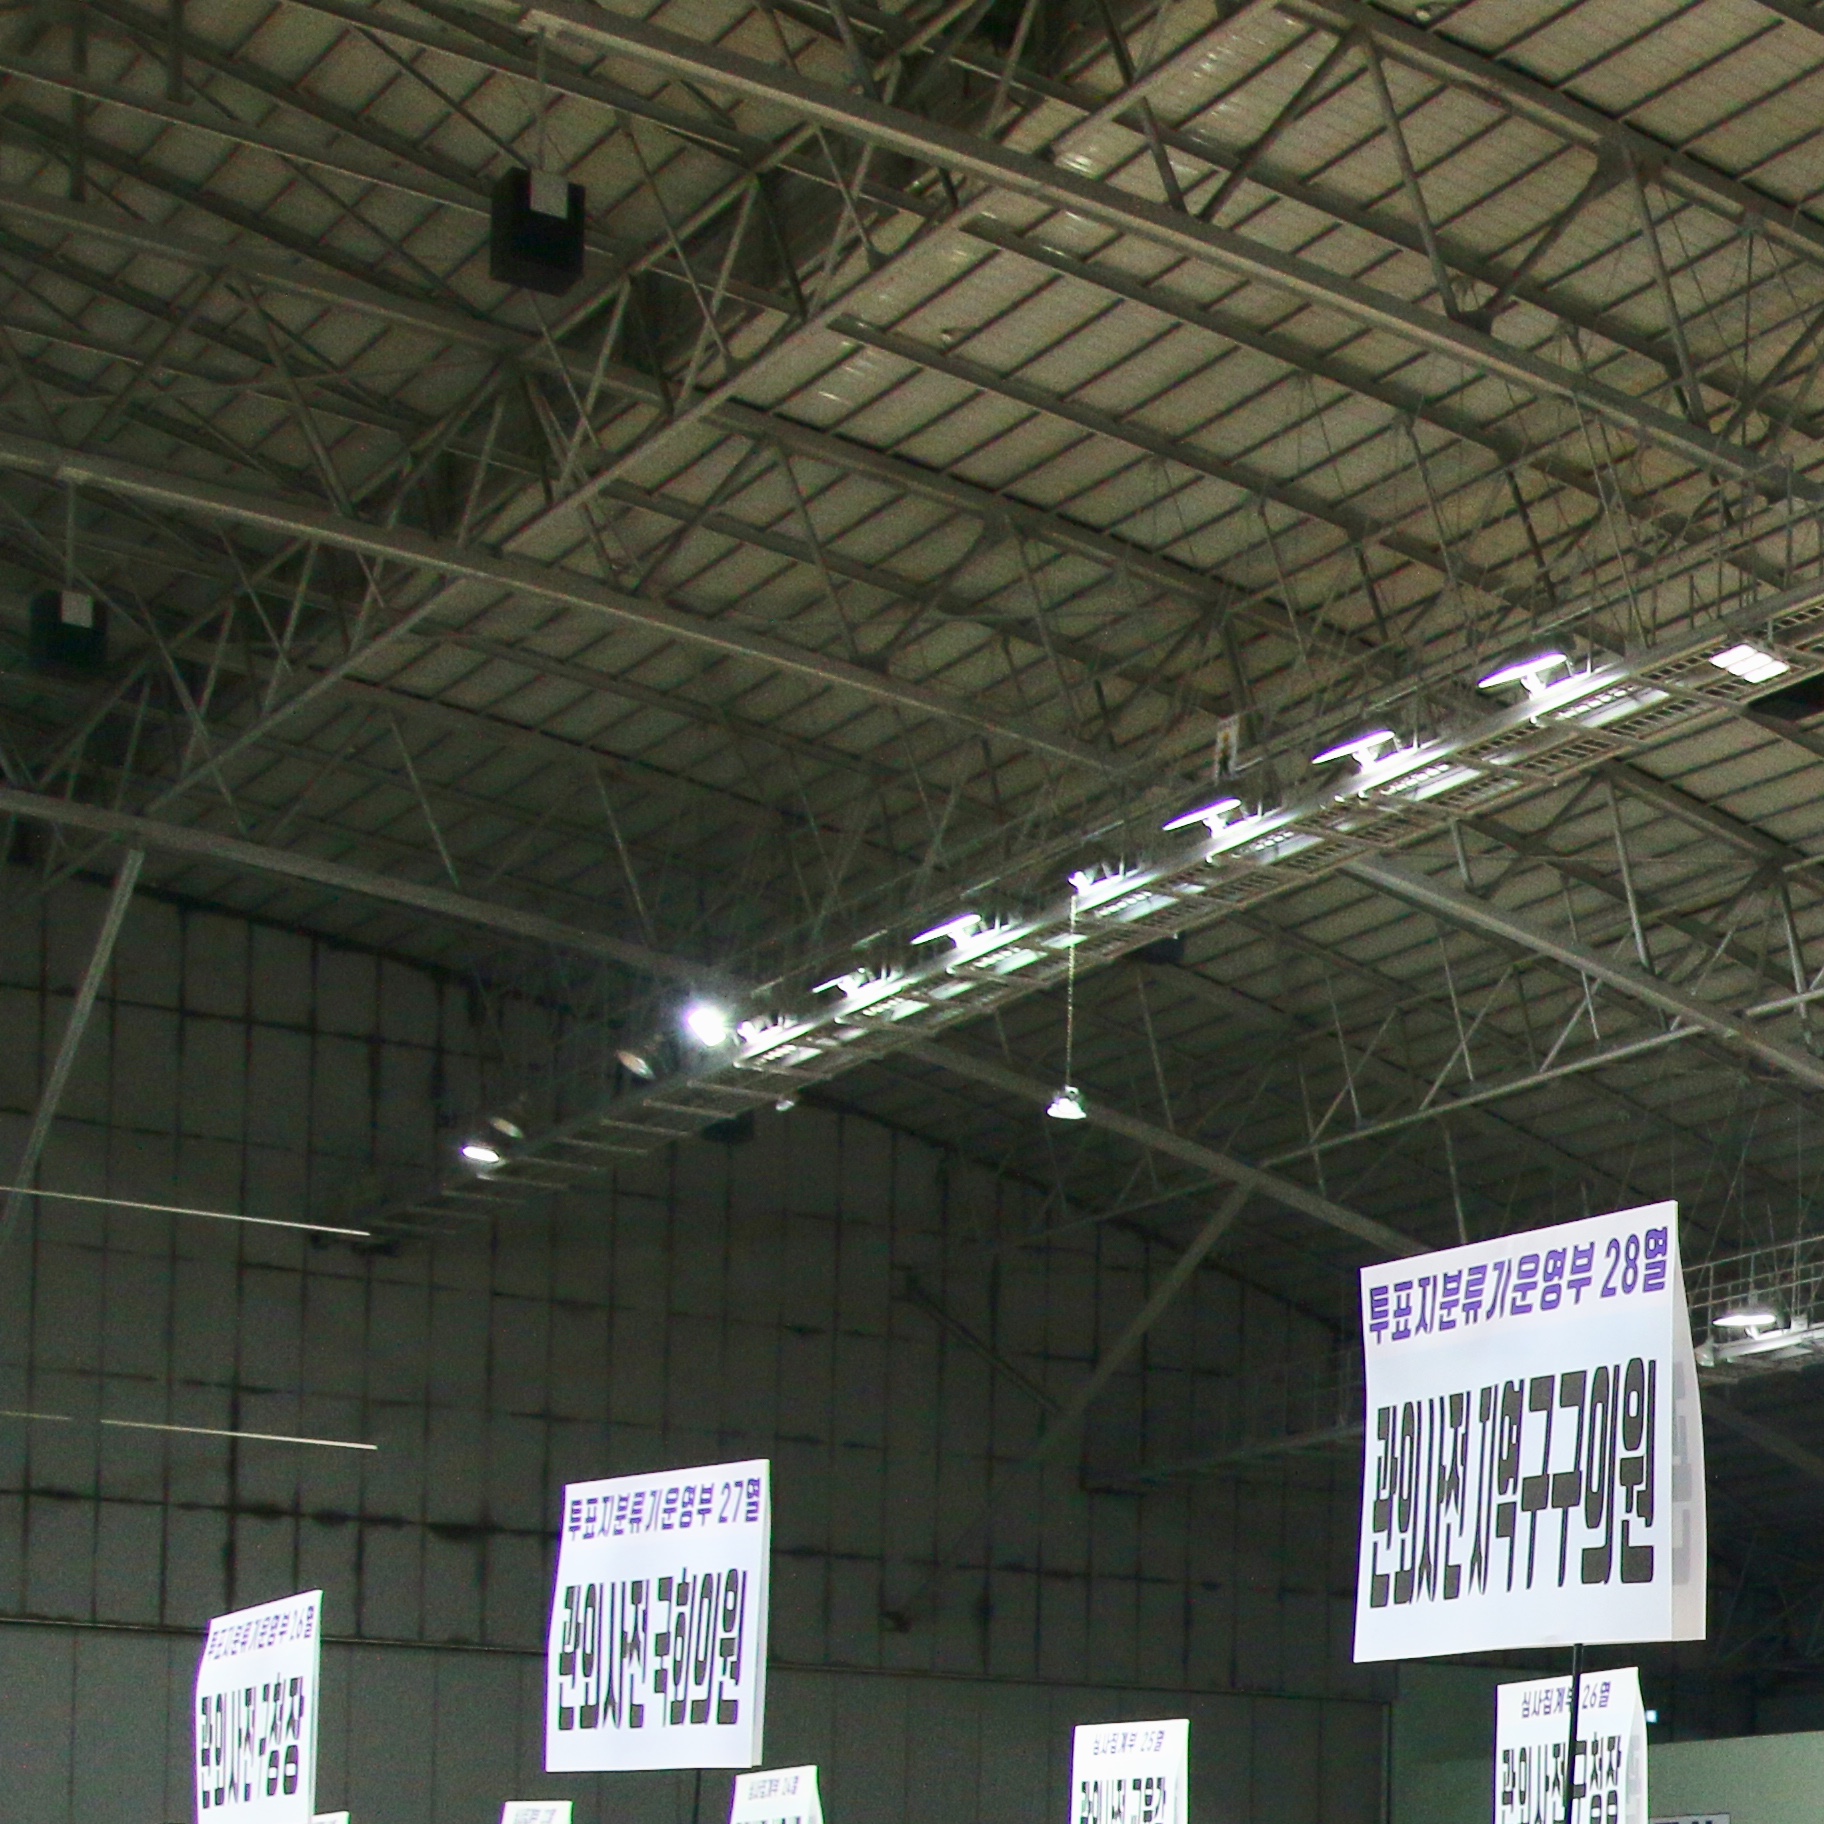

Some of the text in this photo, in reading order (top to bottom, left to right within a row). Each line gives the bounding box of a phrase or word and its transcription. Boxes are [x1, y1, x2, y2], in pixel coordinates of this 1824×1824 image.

[1368, 1226, 1668, 1344] 투표지분류기운영부 28열
[568, 1478, 761, 1541] 투표지분류기운영부 27열
[1369, 1358, 1656, 1609] 관외사전 지역구구의원
[558, 1567, 747, 1731] 관외사전 국회의원
[1582, 1681, 1611, 1710] 26열
[201, 1672, 304, 1809] 관외사전 구청장
